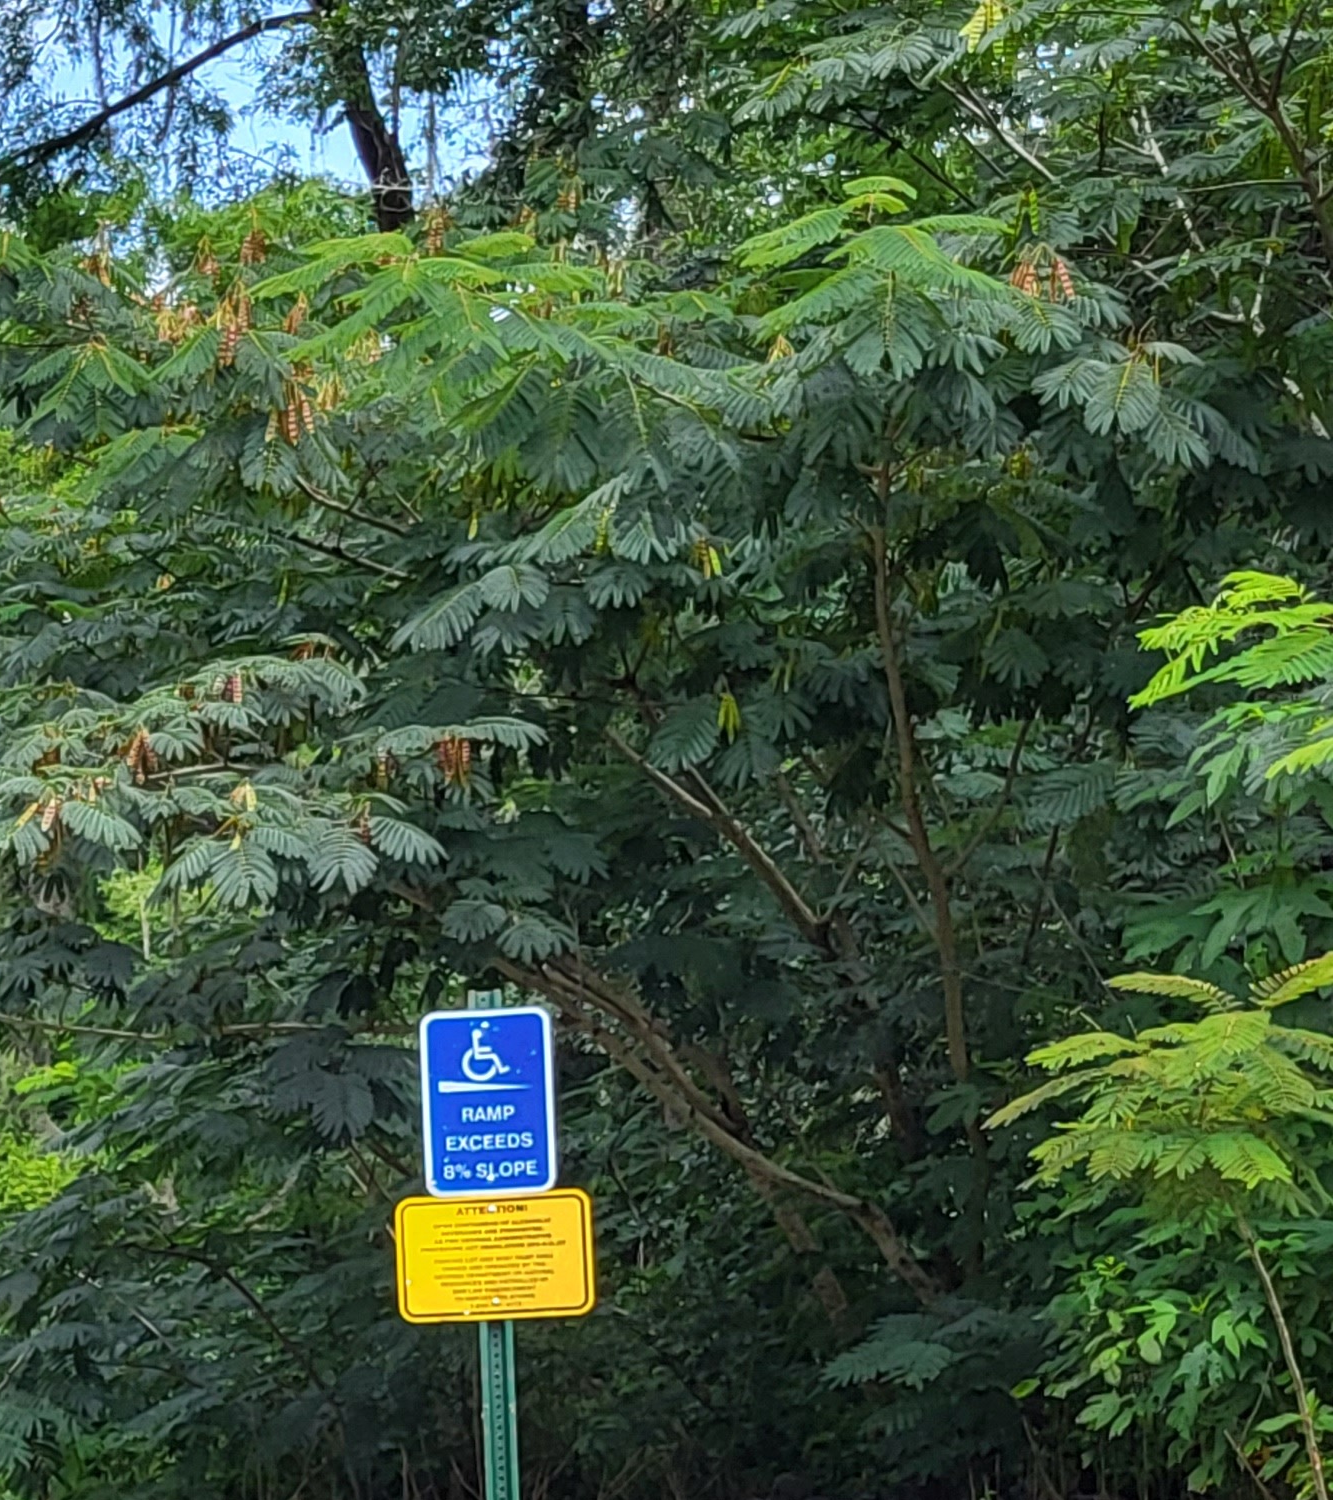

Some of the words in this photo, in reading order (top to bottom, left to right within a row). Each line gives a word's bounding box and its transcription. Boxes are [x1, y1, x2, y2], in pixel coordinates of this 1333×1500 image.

[461, 1105, 515, 1123] RAMP
[445, 1132, 533, 1152] EXCEEDS
[443, 1164, 471, 1180] 8%
[476, 1160, 539, 1180] SLOPE
[456, 1205, 528, 1216] ATTETION!
